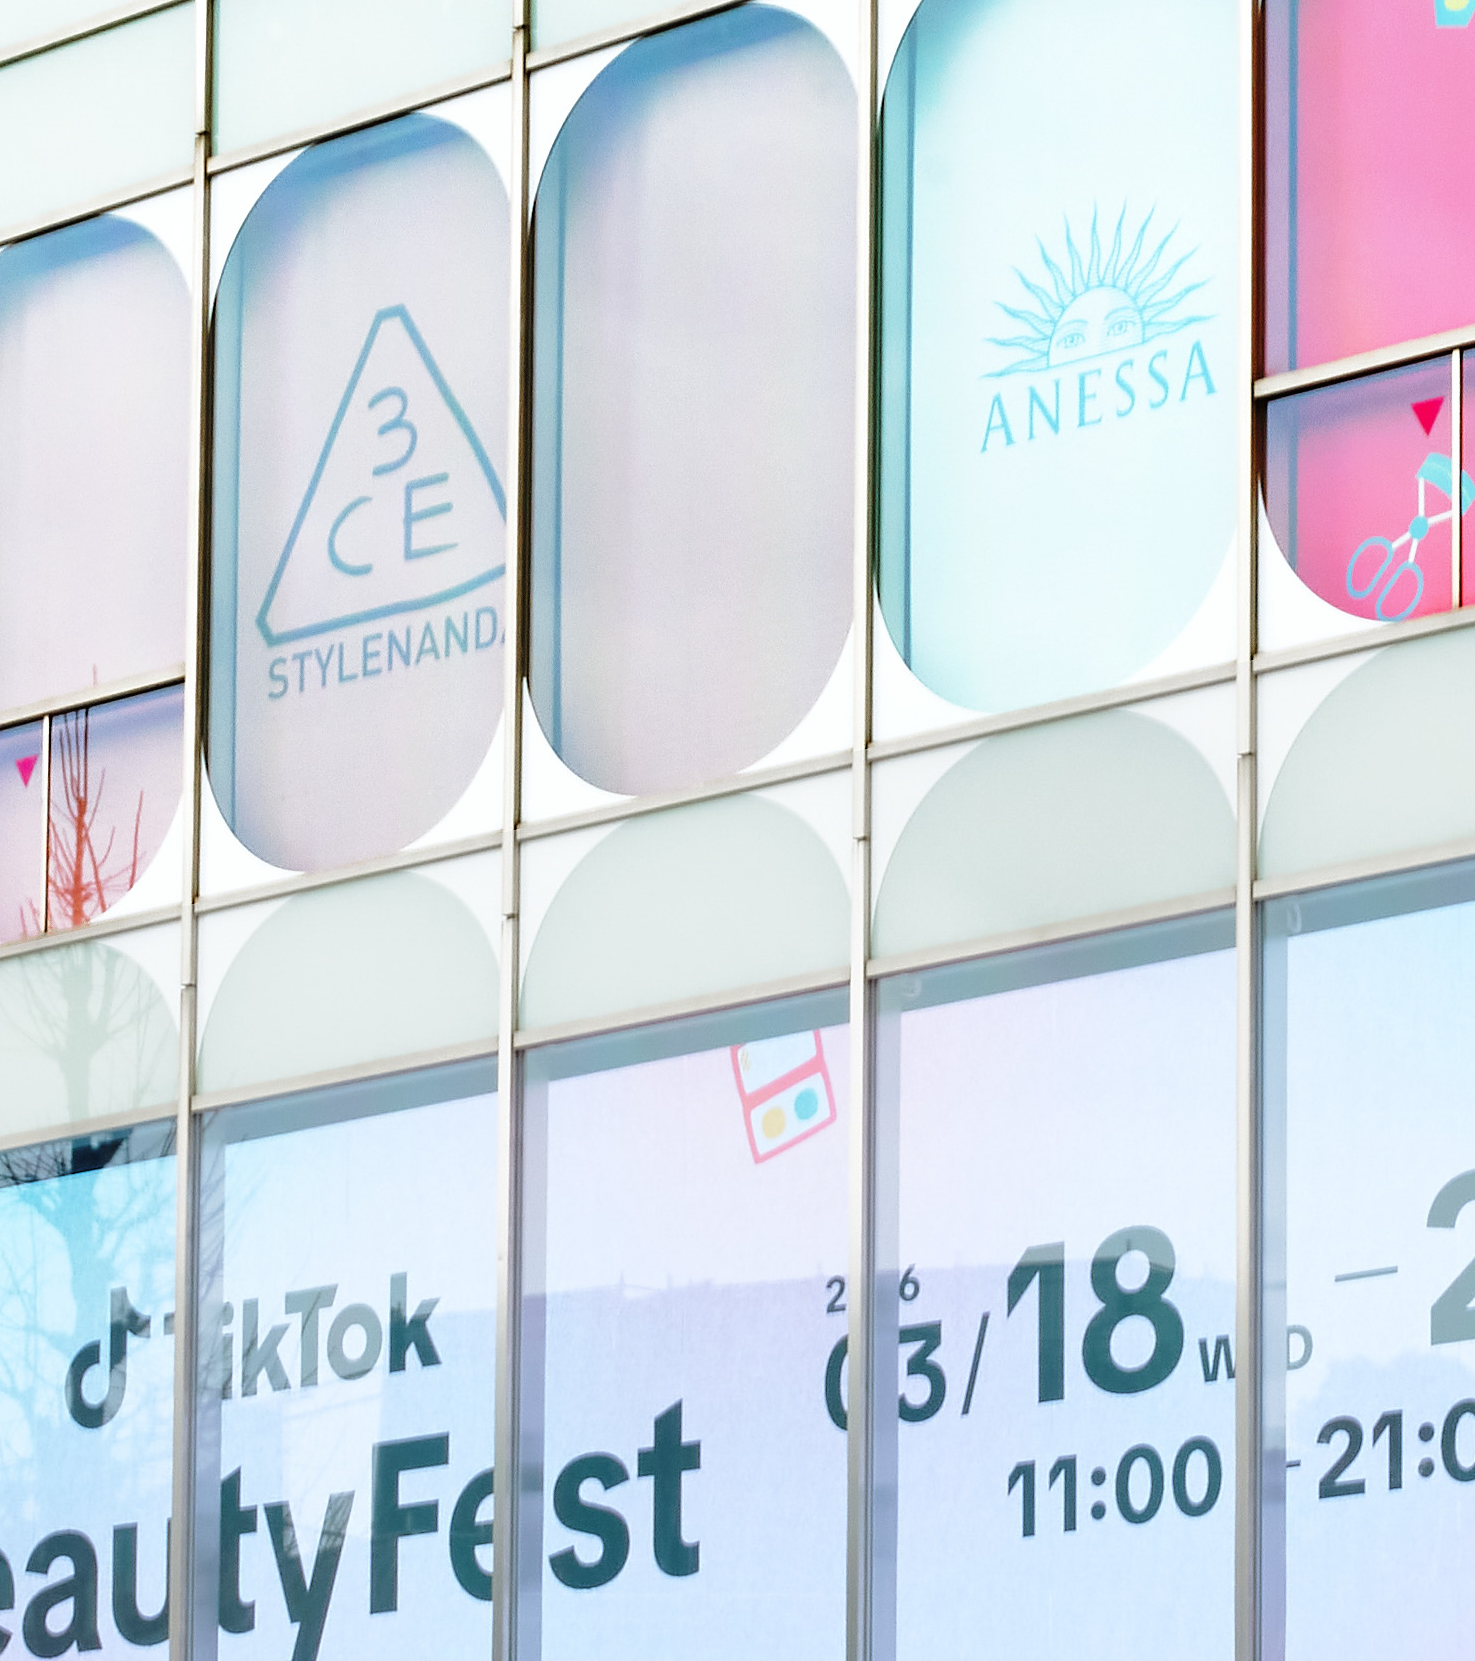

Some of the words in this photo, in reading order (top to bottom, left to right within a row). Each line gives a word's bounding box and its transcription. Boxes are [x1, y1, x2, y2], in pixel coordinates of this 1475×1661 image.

[978, 339, 1219, 455] ANESSA
[266, 606, 507, 702] STYLENAND
[165, 1271, 443, 1401] ikTok
[826, 1263, 920, 1315] 26
[1199, 1324, 1314, 1384] WD
[1007, 1434, 1223, 1538] 11:00
